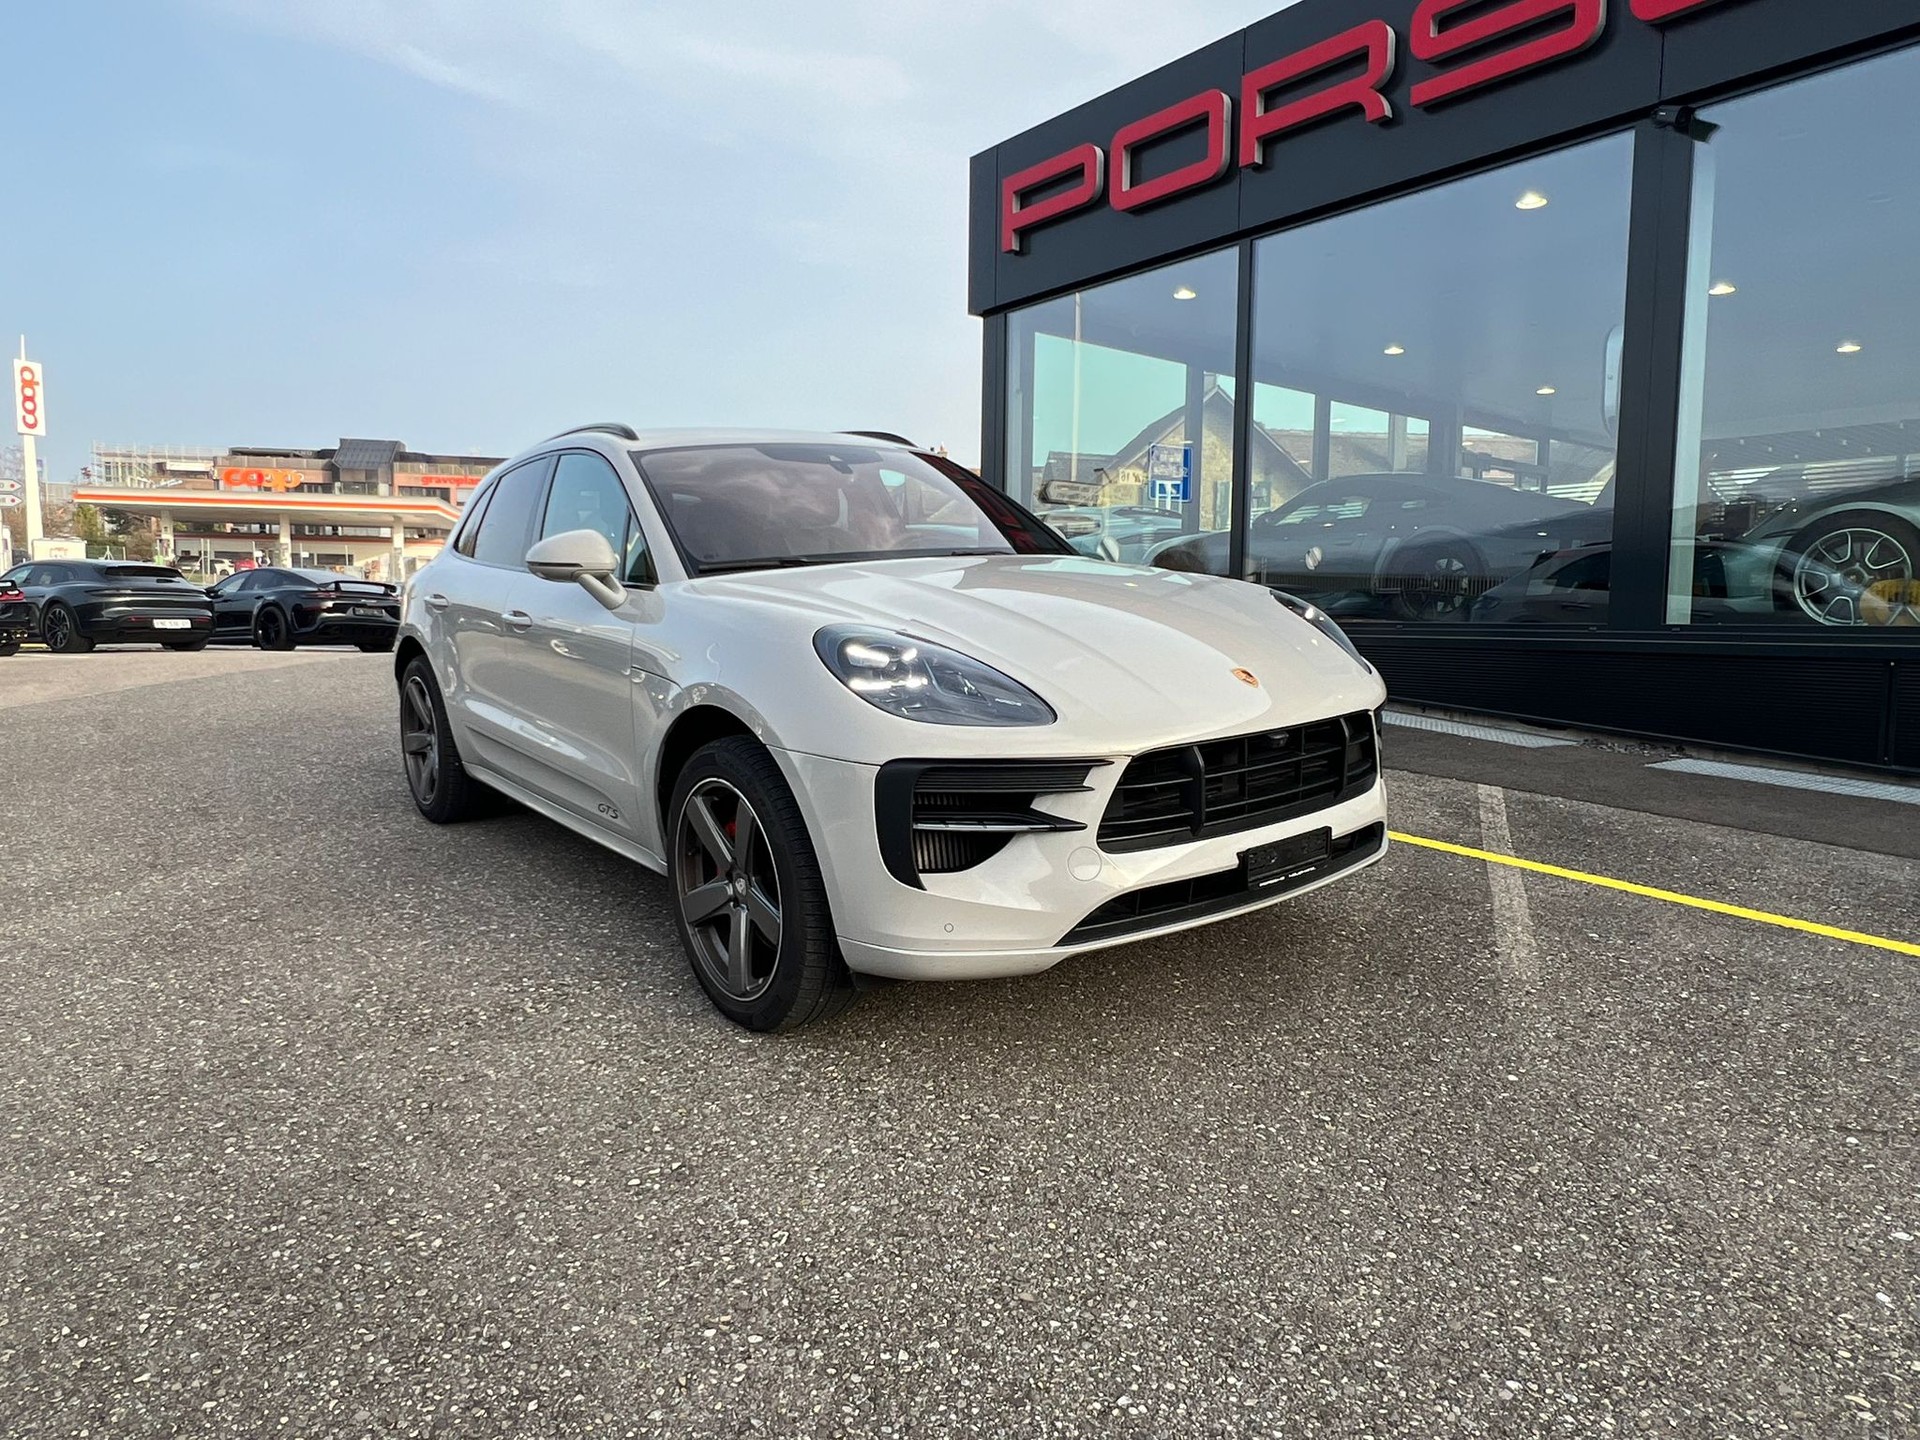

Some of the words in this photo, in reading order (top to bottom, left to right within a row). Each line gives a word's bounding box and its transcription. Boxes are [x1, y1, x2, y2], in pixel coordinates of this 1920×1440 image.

[1002, 0, 1724, 254] PORS
[20, 366, 40, 429] coop
[223, 468, 304, 492] coop
[597, 803, 619, 820] GTS
